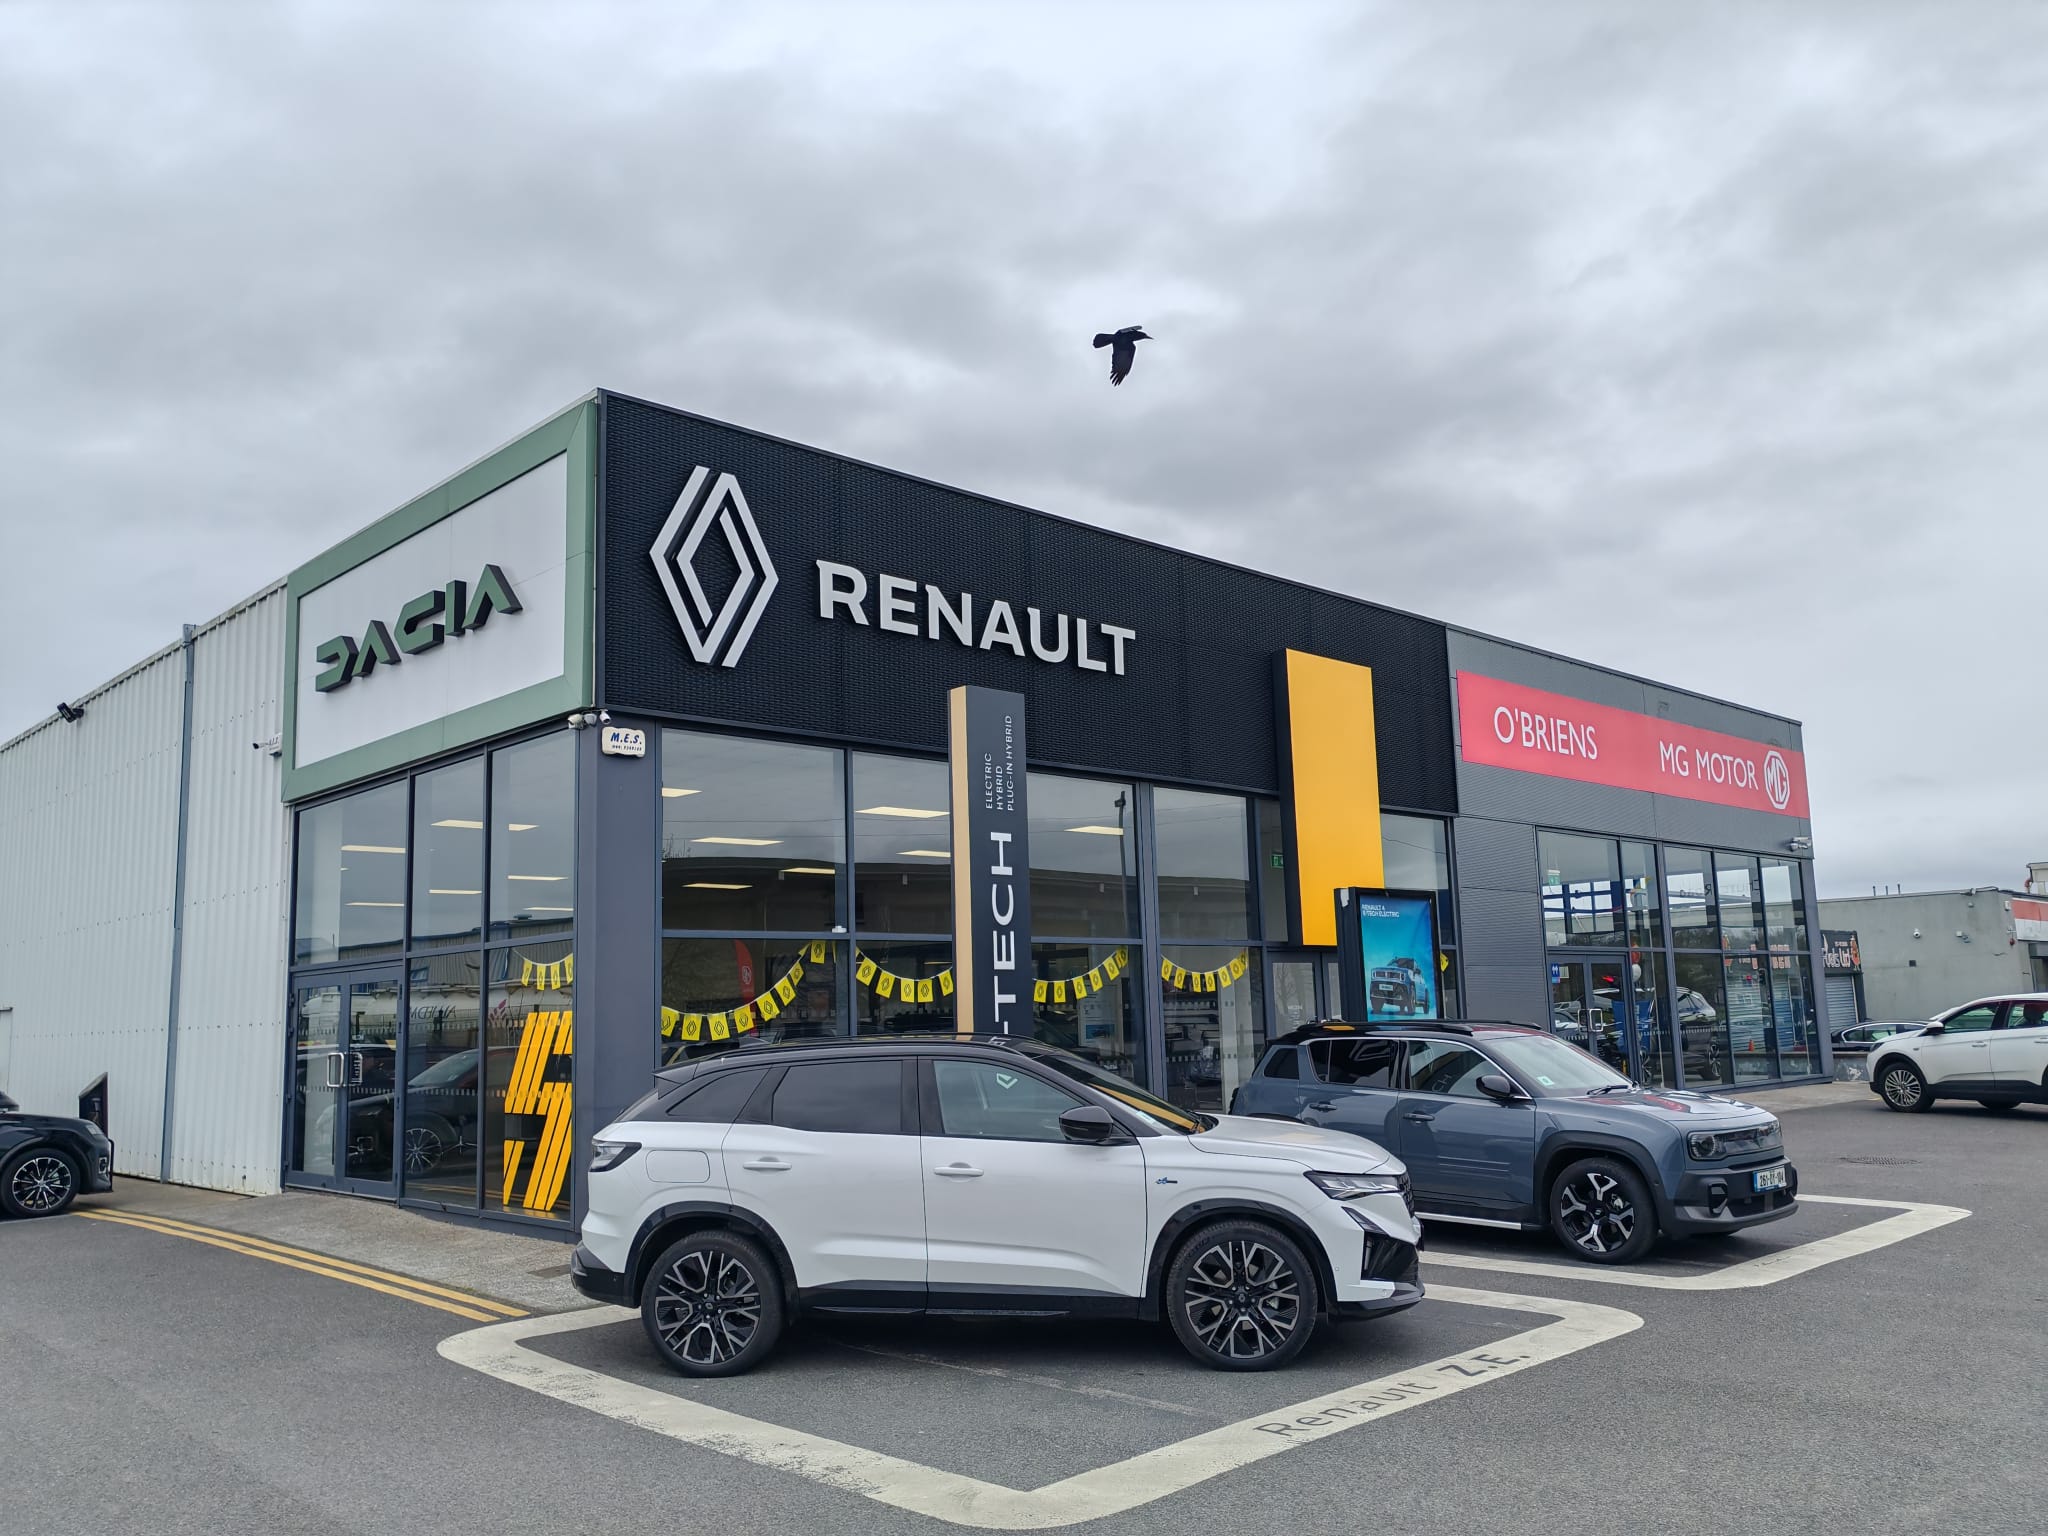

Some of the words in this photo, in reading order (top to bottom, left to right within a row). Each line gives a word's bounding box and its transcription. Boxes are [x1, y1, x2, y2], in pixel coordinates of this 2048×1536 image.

[315, 564, 523, 692] DACIA
[816, 560, 1136, 676] RENAULT
[611, 732, 642, 745] M.E.S.
[1004, 715, 1014, 759] HYBRID
[1494, 706, 1598, 760] O'BRIENS
[1660, 740, 1690, 777] MG
[1696, 748, 1759, 791] MOTOR
[984, 752, 993, 809] ELECTRIC
[995, 765, 1004, 810] HYBRID
[1006, 762, 1015, 811] PLUG-IN
[990, 831, 1017, 1035] -TECH
[1253, 1381, 1438, 1437] Renault
[1436, 1353, 1531, 1377] Z.E.
